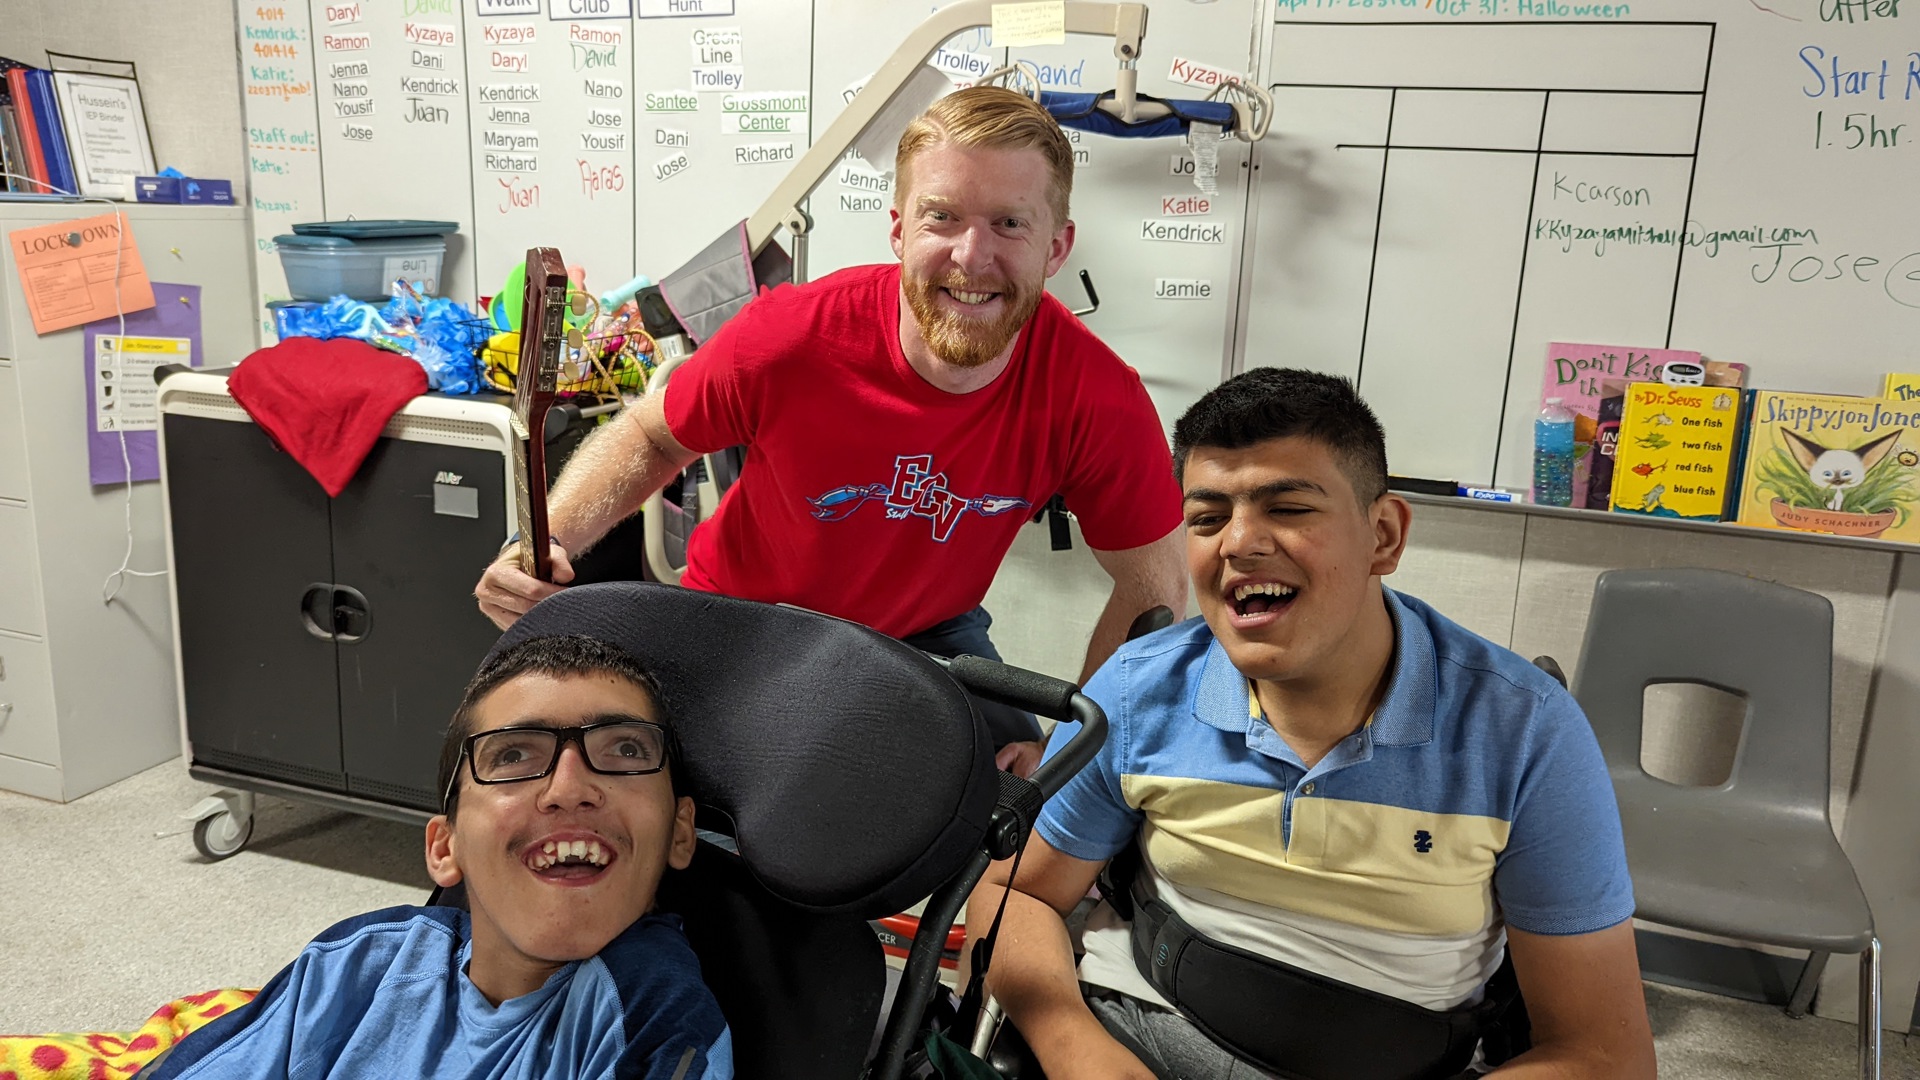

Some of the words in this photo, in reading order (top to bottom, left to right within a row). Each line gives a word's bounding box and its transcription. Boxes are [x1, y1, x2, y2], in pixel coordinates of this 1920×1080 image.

[326, 4, 361, 22] Daryl
[569, 0, 610, 14] Club
[1518, 0, 1630, 18] Halloween
[324, 34, 370, 50] Ramon
[405, 23, 455, 46] Kyzaya
[484, 25, 535, 44] Kyzaya
[570, 24, 622, 45] Ramon
[412, 50, 443, 69] Dani
[492, 52, 528, 72] Daryl
[570, 43, 617, 73] David
[701, 48, 733, 64] Line
[936, 48, 990, 78] Trolley
[329, 63, 369, 79] Jenna
[692, 70, 743, 90] Trolley
[1016, 59, 1085, 88] David
[1799, 45, 1891, 101] Start
[333, 82, 369, 98] Nano
[401, 78, 459, 95] Kendrick
[479, 85, 540, 101] Kendrick
[585, 79, 623, 99] Nano
[334, 99, 375, 116] Yousif
[645, 93, 698, 111] Santee
[722, 94, 807, 112] Grossmont
[404, 98, 450, 125] Juan
[488, 107, 531, 124] Jenna
[588, 110, 623, 127] Jose
[738, 113, 791, 131] Center
[250, 127, 287, 145] Staff
[342, 125, 374, 140] Jose
[484, 131, 540, 151] Maryam
[581, 133, 626, 150] Yousif
[655, 129, 690, 147] Dani
[735, 143, 794, 163] Richard
[485, 155, 537, 171] Richard
[656, 155, 689, 181] Jose
[840, 168, 890, 192] Jenna
[498, 175, 541, 215] Juan
[840, 194, 883, 211] Nano
[1162, 196, 1210, 215] Katie
[21, 224, 121, 256] LOCKOWN
[1142, 221, 1223, 243] Kendrick
[1750, 243, 1879, 284] Jose
[1156, 280, 1211, 298] Jamie
[1554, 352, 1619, 386] Don't
[1644, 391, 1665, 406] Dr.
[1666, 390, 1703, 408] Seuss
[1681, 416, 1701, 427] One
[1703, 417, 1723, 428] fish
[1681, 440, 1701, 450] two
[1703, 440, 1723, 452] fish
[1675, 462, 1692, 471] red
[1693, 462, 1713, 473] fish
[1474, 491, 1496, 500] EXPO
[1673, 484, 1694, 494] blue
[1696, 485, 1716, 496] fish
[885, 508, 911, 520] Staff
[1780, 511, 1809, 523] JUDY
[1814, 517, 1881, 529] SCHACHNER
[877, 932, 897, 945] CER
